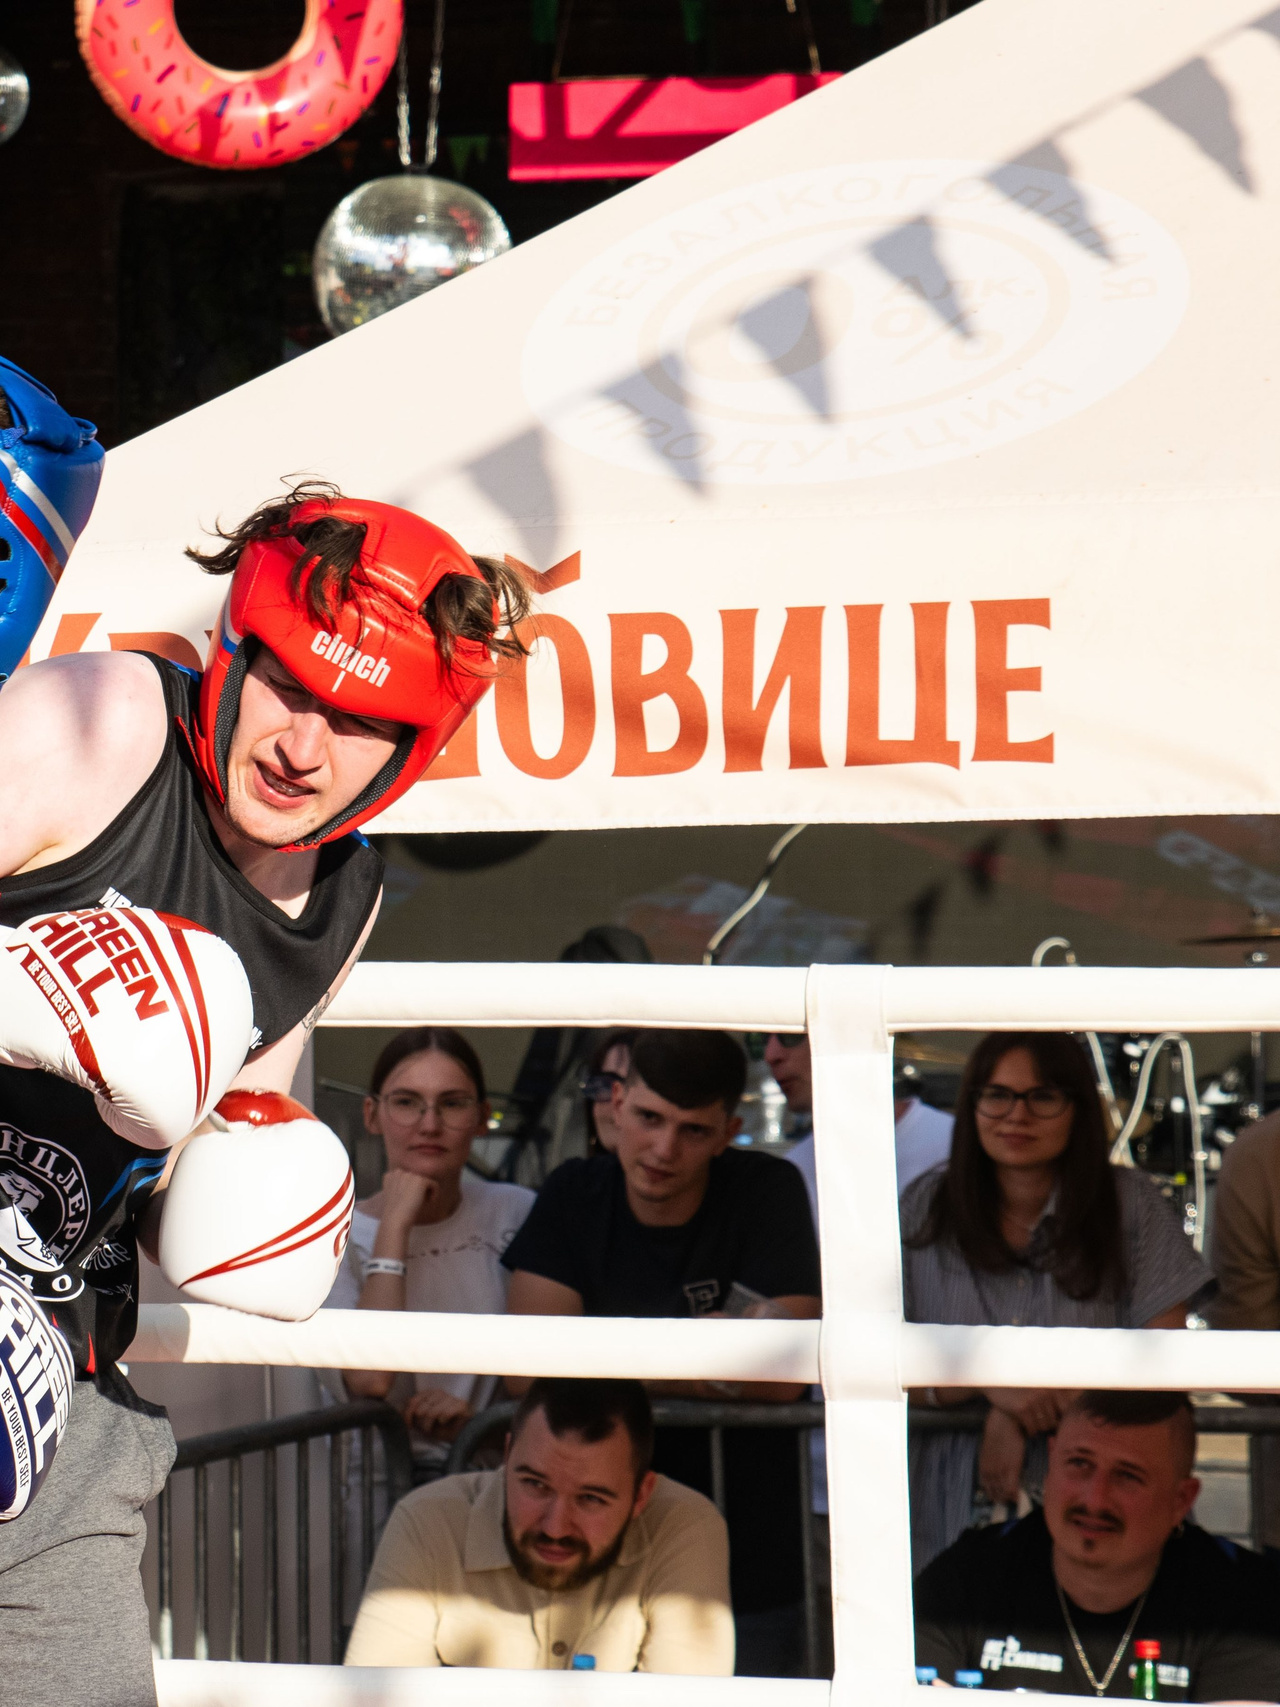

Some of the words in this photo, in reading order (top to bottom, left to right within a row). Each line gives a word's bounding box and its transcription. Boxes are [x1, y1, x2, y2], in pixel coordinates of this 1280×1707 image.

[580, 376, 1075, 475] ПРОДУКЦИЯ
[310, 629, 391, 689] clinch
[27, 959, 42, 975] BE
[37, 972, 57, 997] YOUR
[50, 990, 71, 1017] BEST
[29, 913, 100, 1018] HILL
[1, 1387, 9, 1406] BE
[6, 1404, 22, 1438] YOUR
[15, 1435, 29, 1465] BEST
[19, 1462, 30, 1489] SELF
